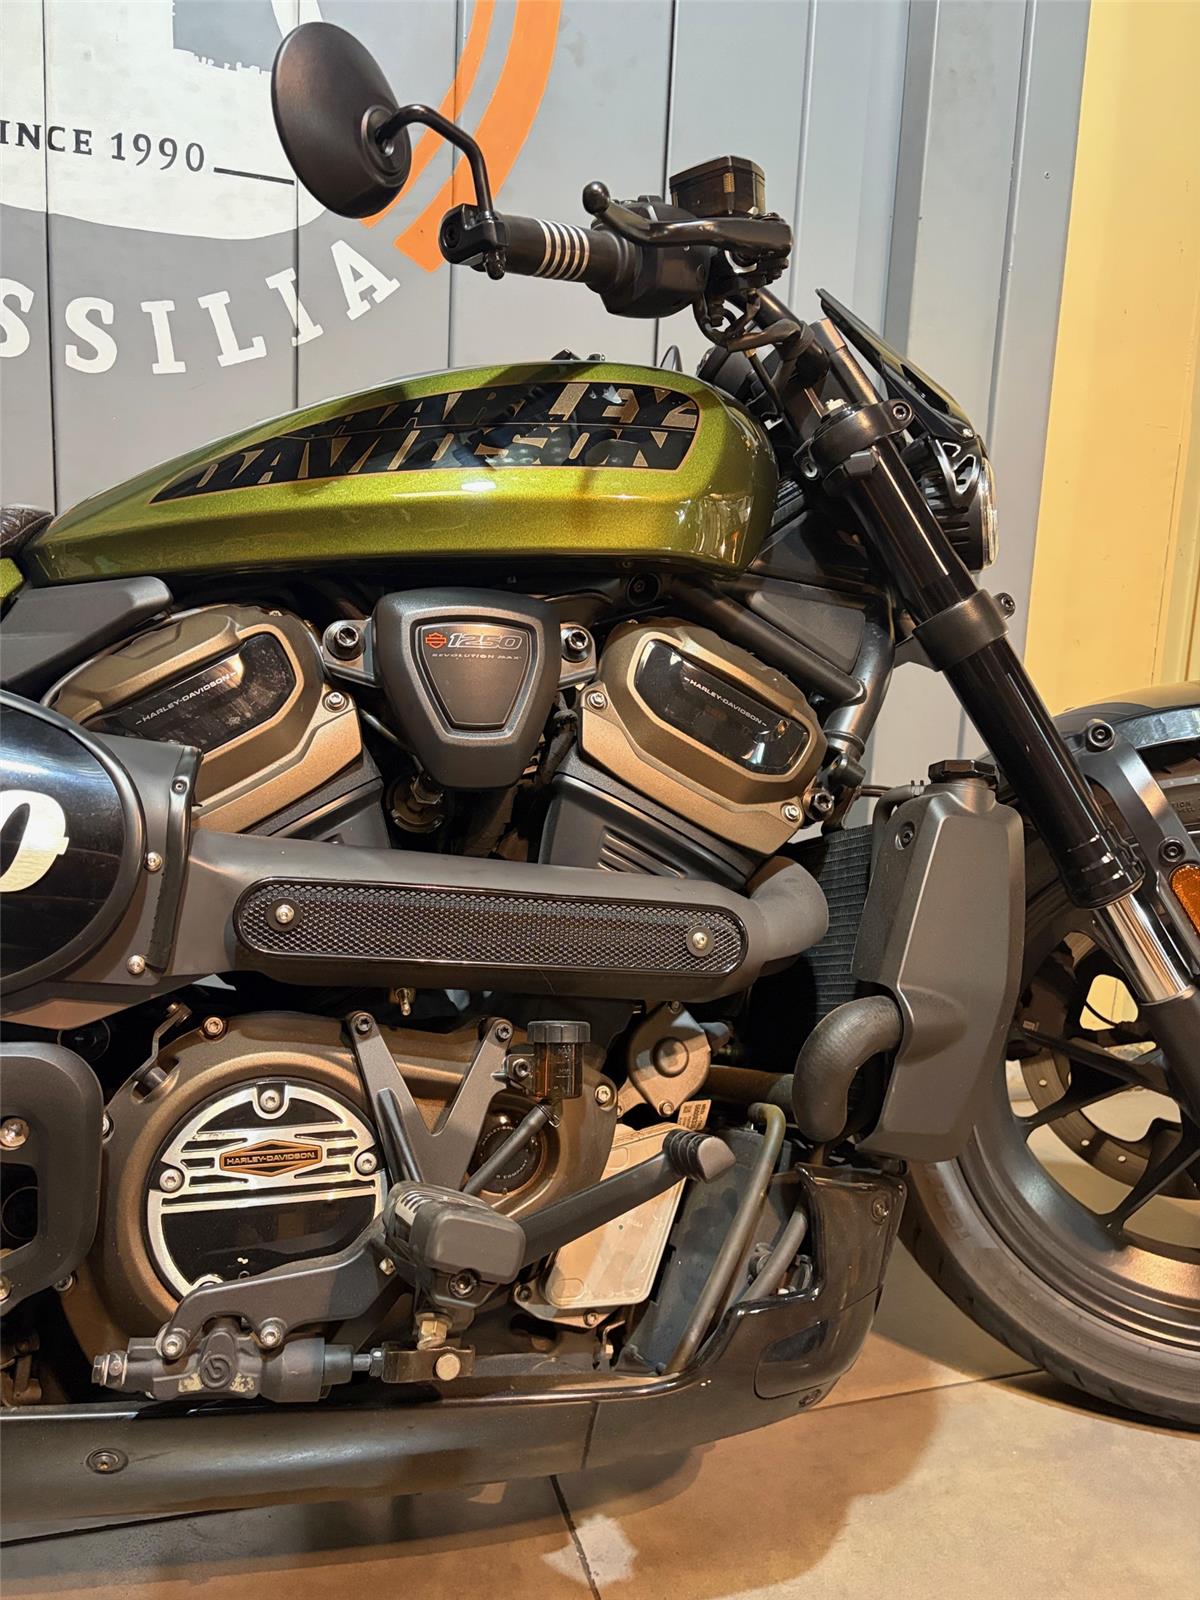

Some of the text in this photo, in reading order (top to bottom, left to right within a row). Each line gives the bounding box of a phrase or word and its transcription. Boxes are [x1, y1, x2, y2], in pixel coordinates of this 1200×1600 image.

[110, 132, 205, 172] 1990
[447, 632, 523, 650] 1250
[431, 652, 496, 660] REVOLUTION
[226, 1151, 316, 1165] HARLEY-DAVIDSON
